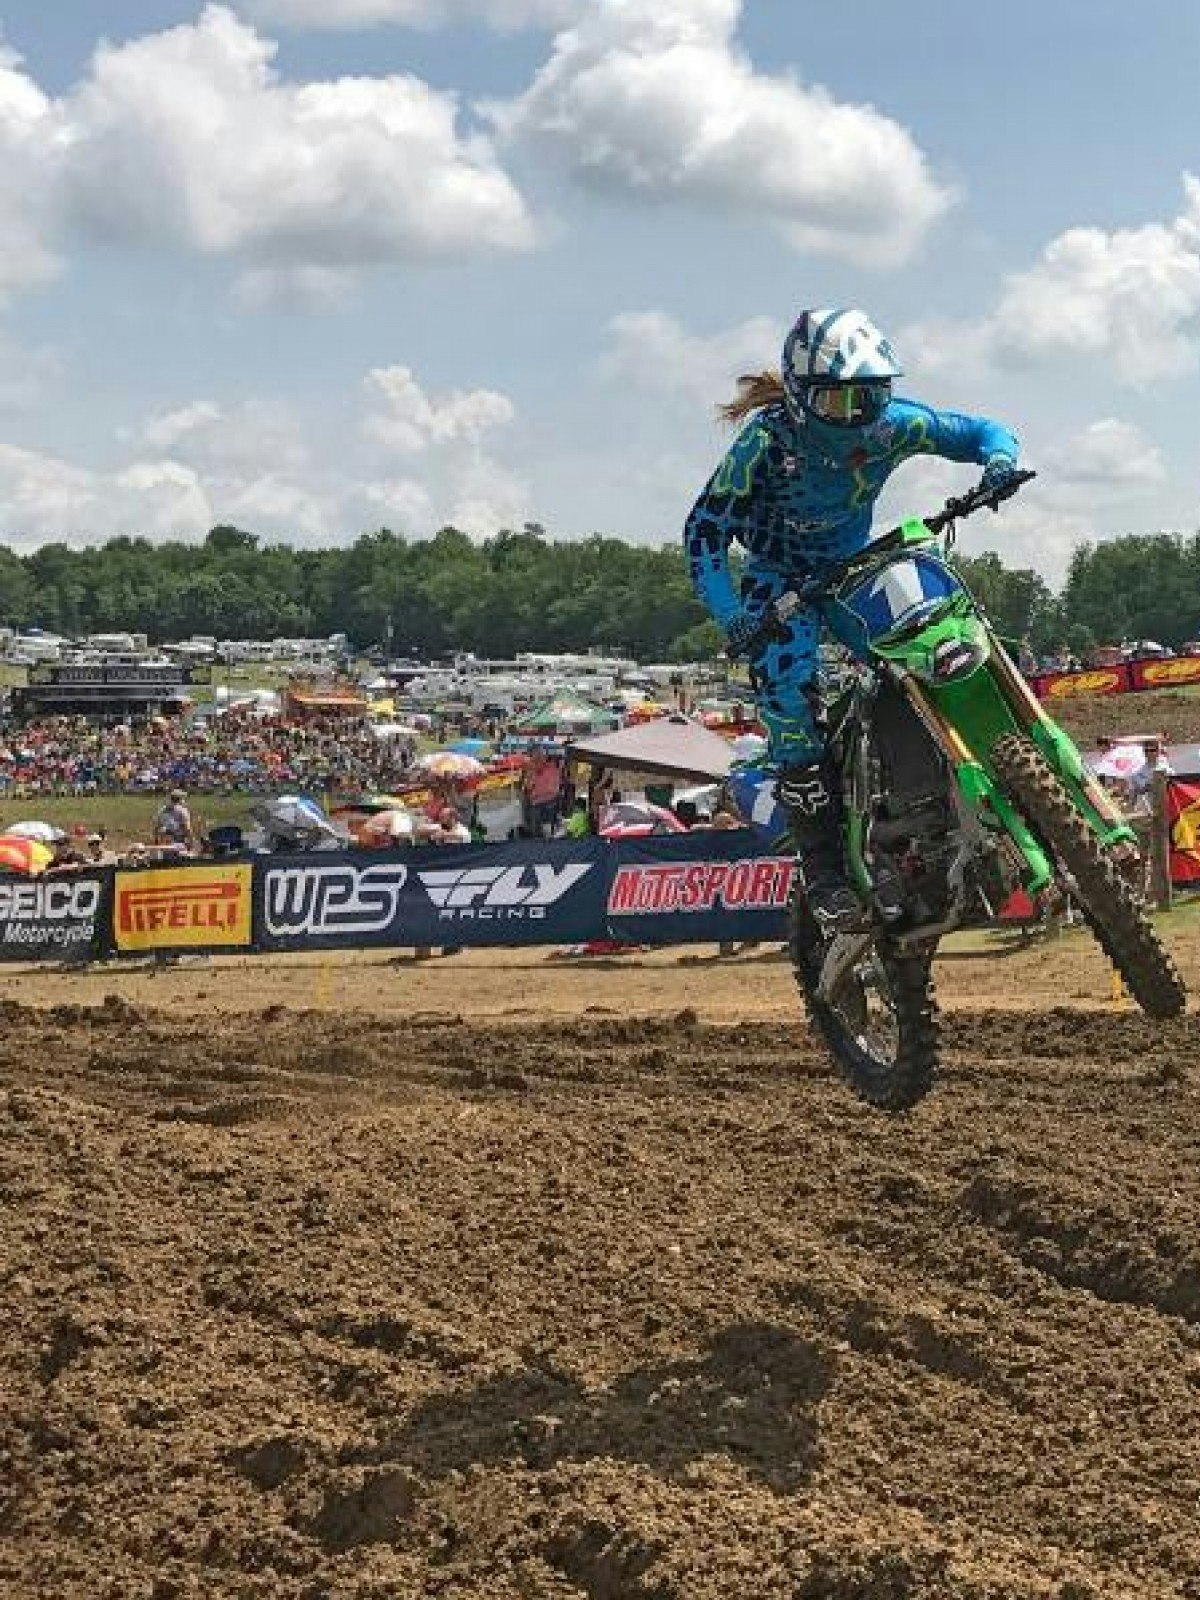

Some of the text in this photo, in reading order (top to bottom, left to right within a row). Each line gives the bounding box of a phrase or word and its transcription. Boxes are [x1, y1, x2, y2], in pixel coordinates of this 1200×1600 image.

[869, 558, 925, 620] 1
[119, 883, 241, 932] PIRELLI
[265, 864, 407, 934] WPS
[417, 864, 594, 907] FLY
[3, 920, 94, 947] Motorcycle
[438, 908, 547, 920] RACING
